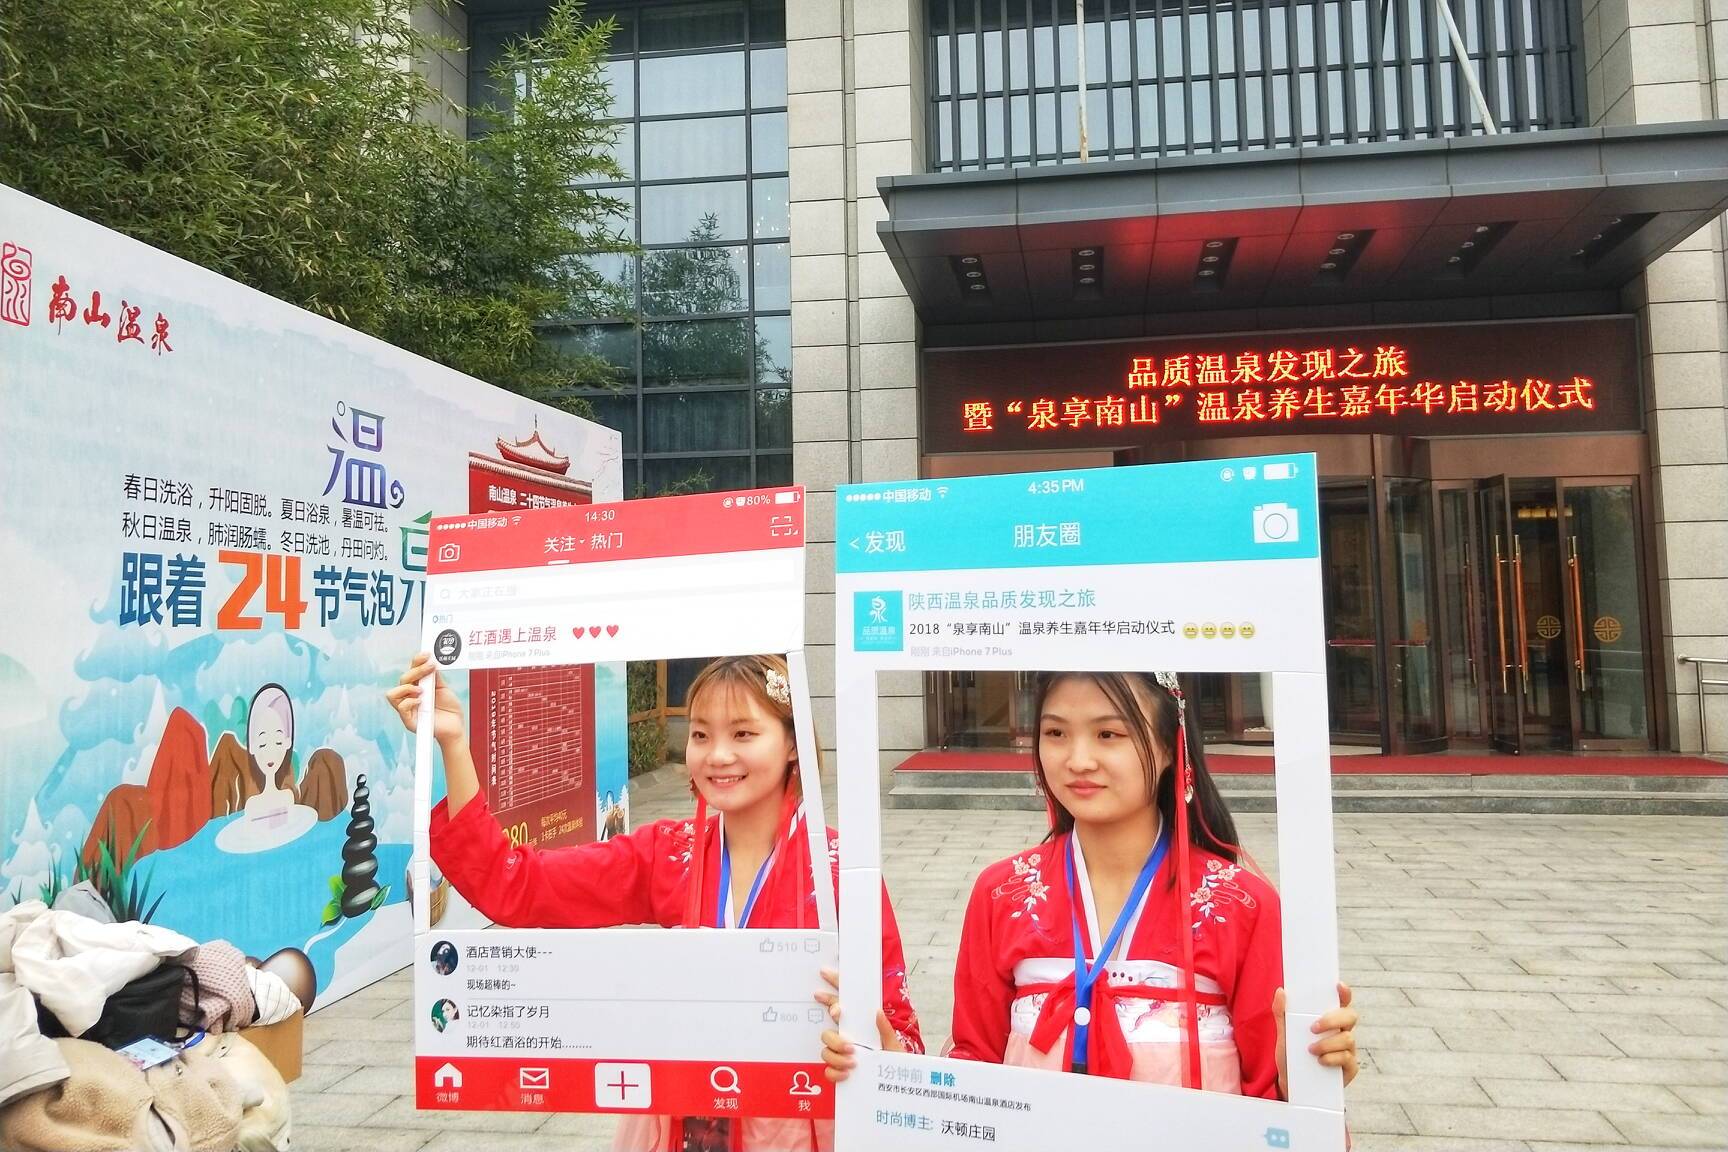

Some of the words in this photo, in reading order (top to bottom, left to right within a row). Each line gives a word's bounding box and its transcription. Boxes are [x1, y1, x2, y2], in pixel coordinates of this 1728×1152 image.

[48, 275, 173, 356] 南山温泉
[1127, 344, 1409, 390] 品质温泉发现之旅
[488, 484, 517, 506] 南山温泉
[882, 488, 932, 503] 中国移动
[1028, 482, 1060, 495] 4:35
[1061, 479, 1085, 492] PM
[747, 495, 771, 507] 80%
[467, 516, 508, 531] 中国移动
[585, 509, 616, 522] 14:30
[544, 536, 576, 553] 关注
[590, 532, 624, 550] 热门
[864, 530, 907, 554] 发现
[1013, 522, 1082, 549] 朋友圈
[908, 589, 1097, 611] 陕西温泉品质发现之旅
[468, 626, 557, 646] 红酒遇上温泉
[992, 646, 1013, 656] Plus
[467, 1005, 550, 1019] 记忆染指了岁月
[878, 1064, 923, 1084] 1分钟前
[930, 1071, 956, 1087] 删除
[520, 1093, 545, 1105] 消息
[713, 1097, 739, 1110] 发现
[798, 1099, 811, 1112] 我
[941, 1119, 996, 1142] 沃顿庄园
